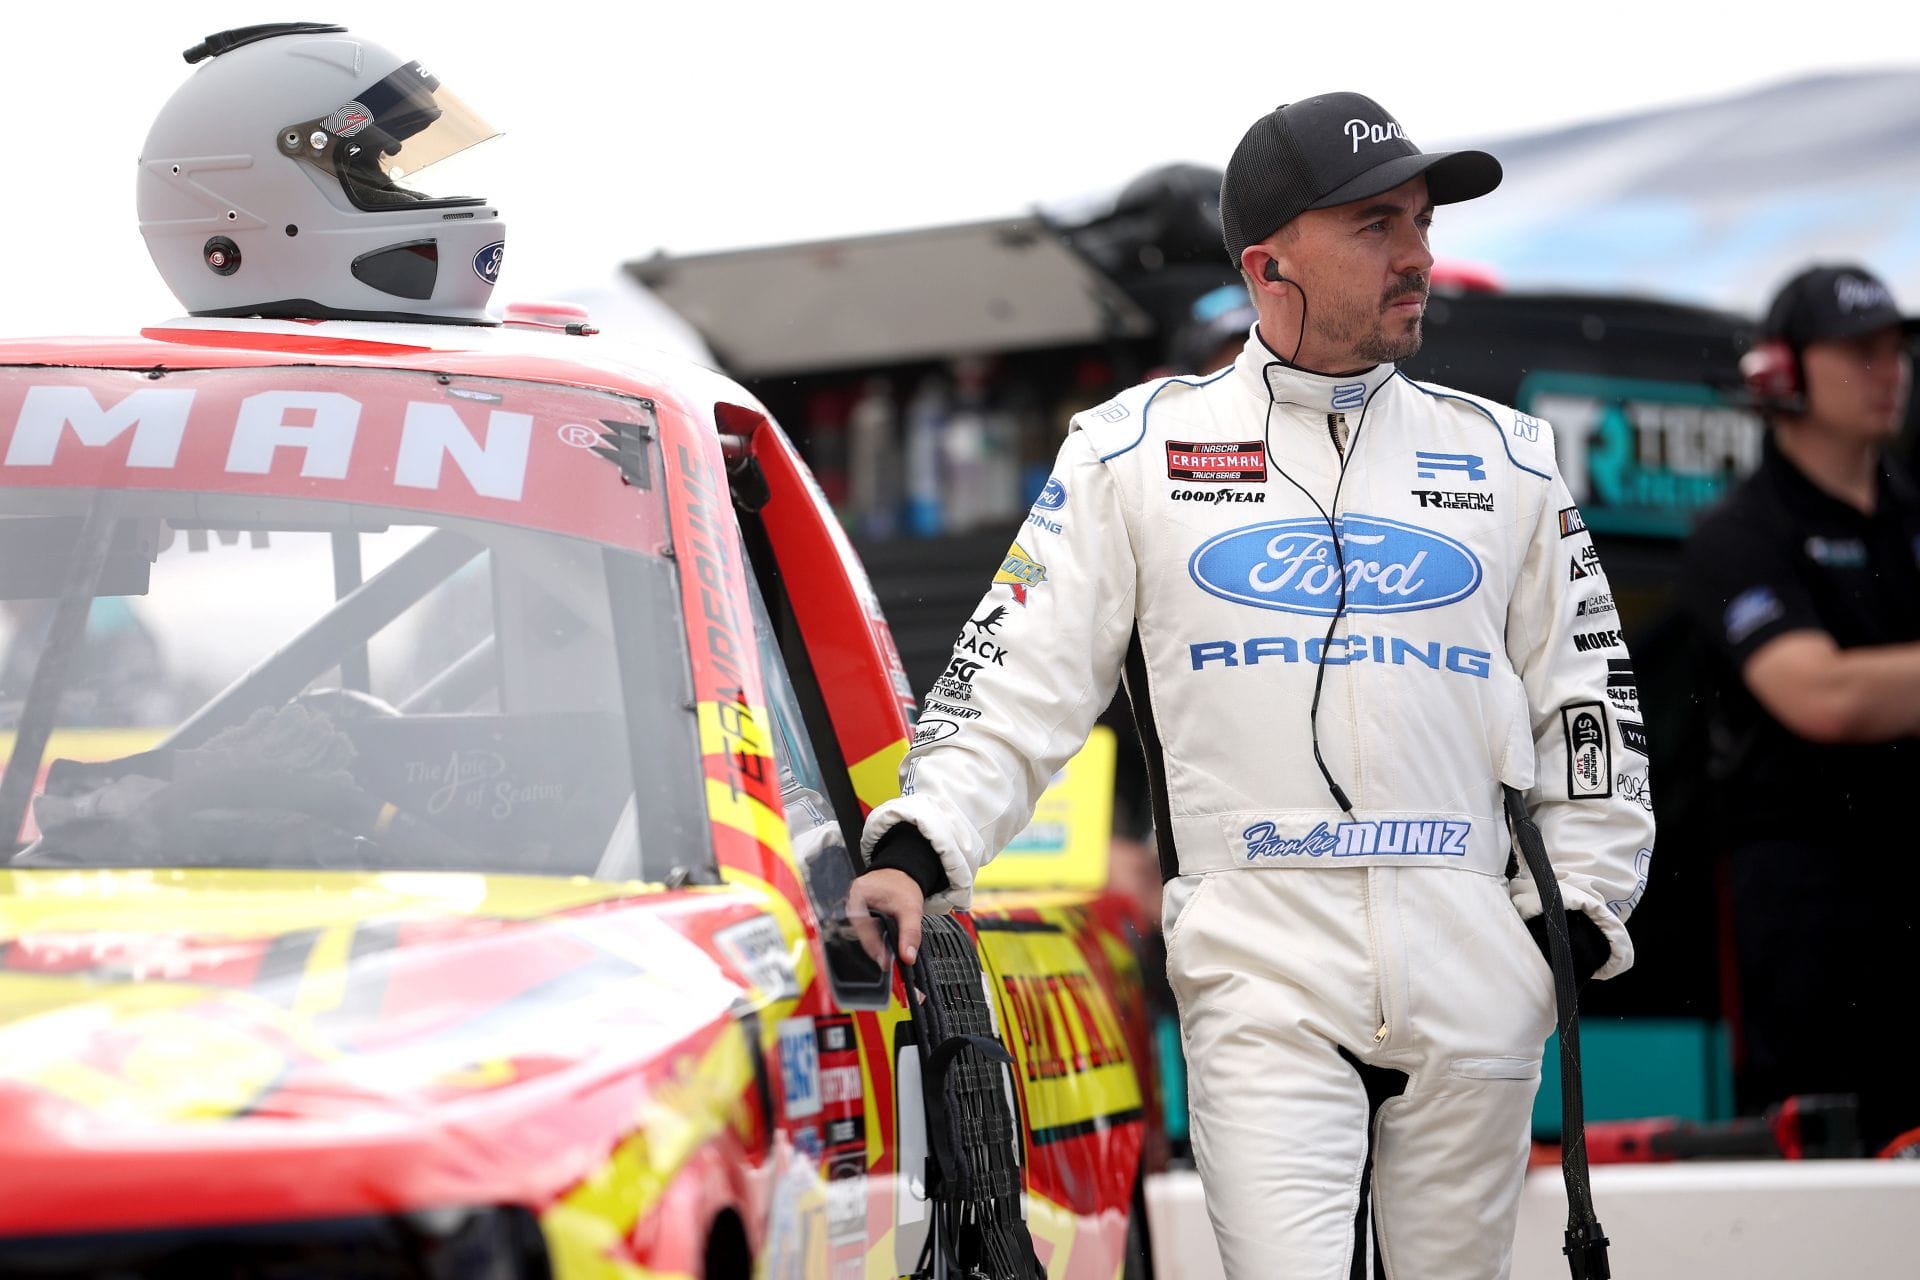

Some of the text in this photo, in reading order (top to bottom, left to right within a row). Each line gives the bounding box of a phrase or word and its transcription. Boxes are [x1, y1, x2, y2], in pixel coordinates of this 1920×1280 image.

[1201, 444, 1239, 453] NASCAR
[1172, 454, 1264, 468] CRAFTSMAN
[1192, 471, 1216, 479] TRUCK
[1441, 491, 1494, 505] TEAM
[1443, 502, 1495, 512] REAUME
[1248, 532, 1428, 597] Ford
[1189, 634, 1492, 679] RACING
[1578, 718, 1598, 742] sfi
[1243, 820, 1472, 861] Frankie MUNIZ
